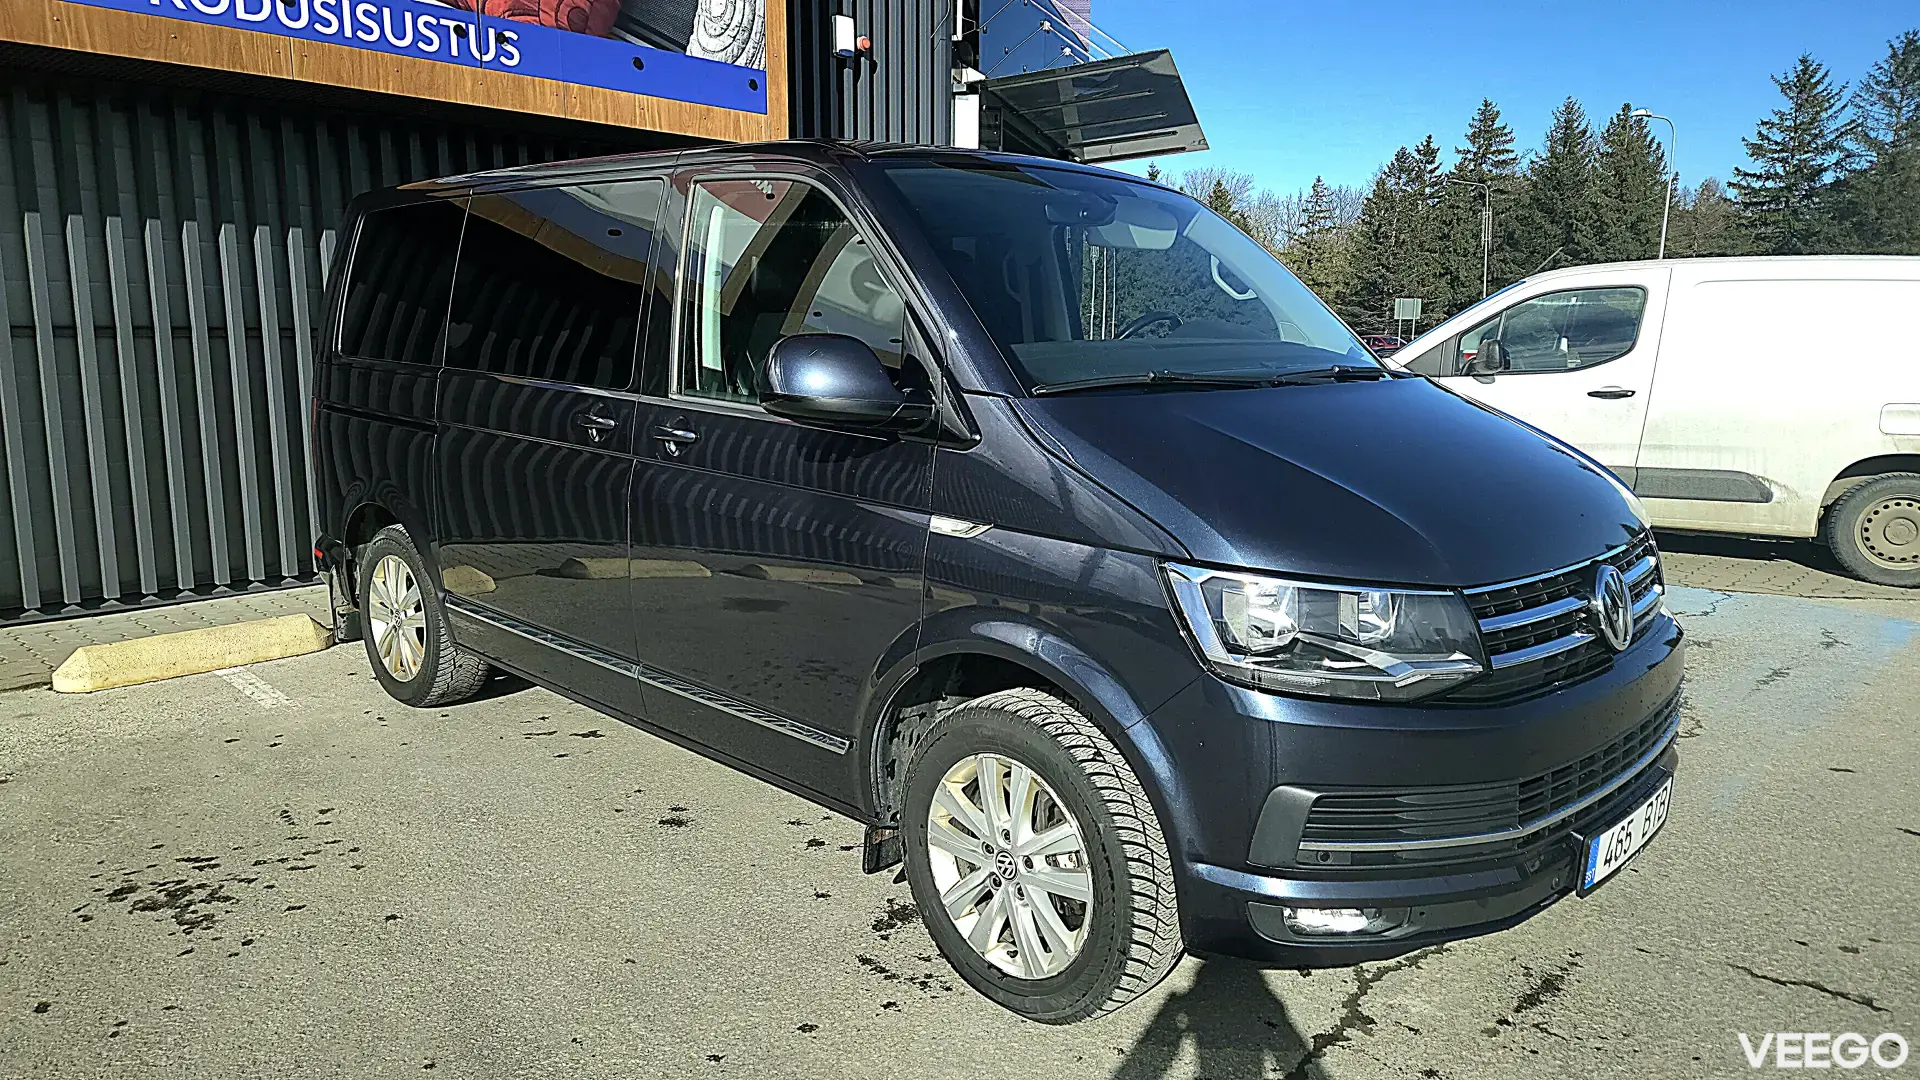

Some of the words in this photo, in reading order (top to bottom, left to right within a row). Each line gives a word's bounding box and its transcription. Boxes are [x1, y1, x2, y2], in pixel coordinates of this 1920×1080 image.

[150, 0, 520, 67] DUSISUSTUS
[1603, 819, 1634, 867] 465
[1642, 785, 1667, 839] BTB
